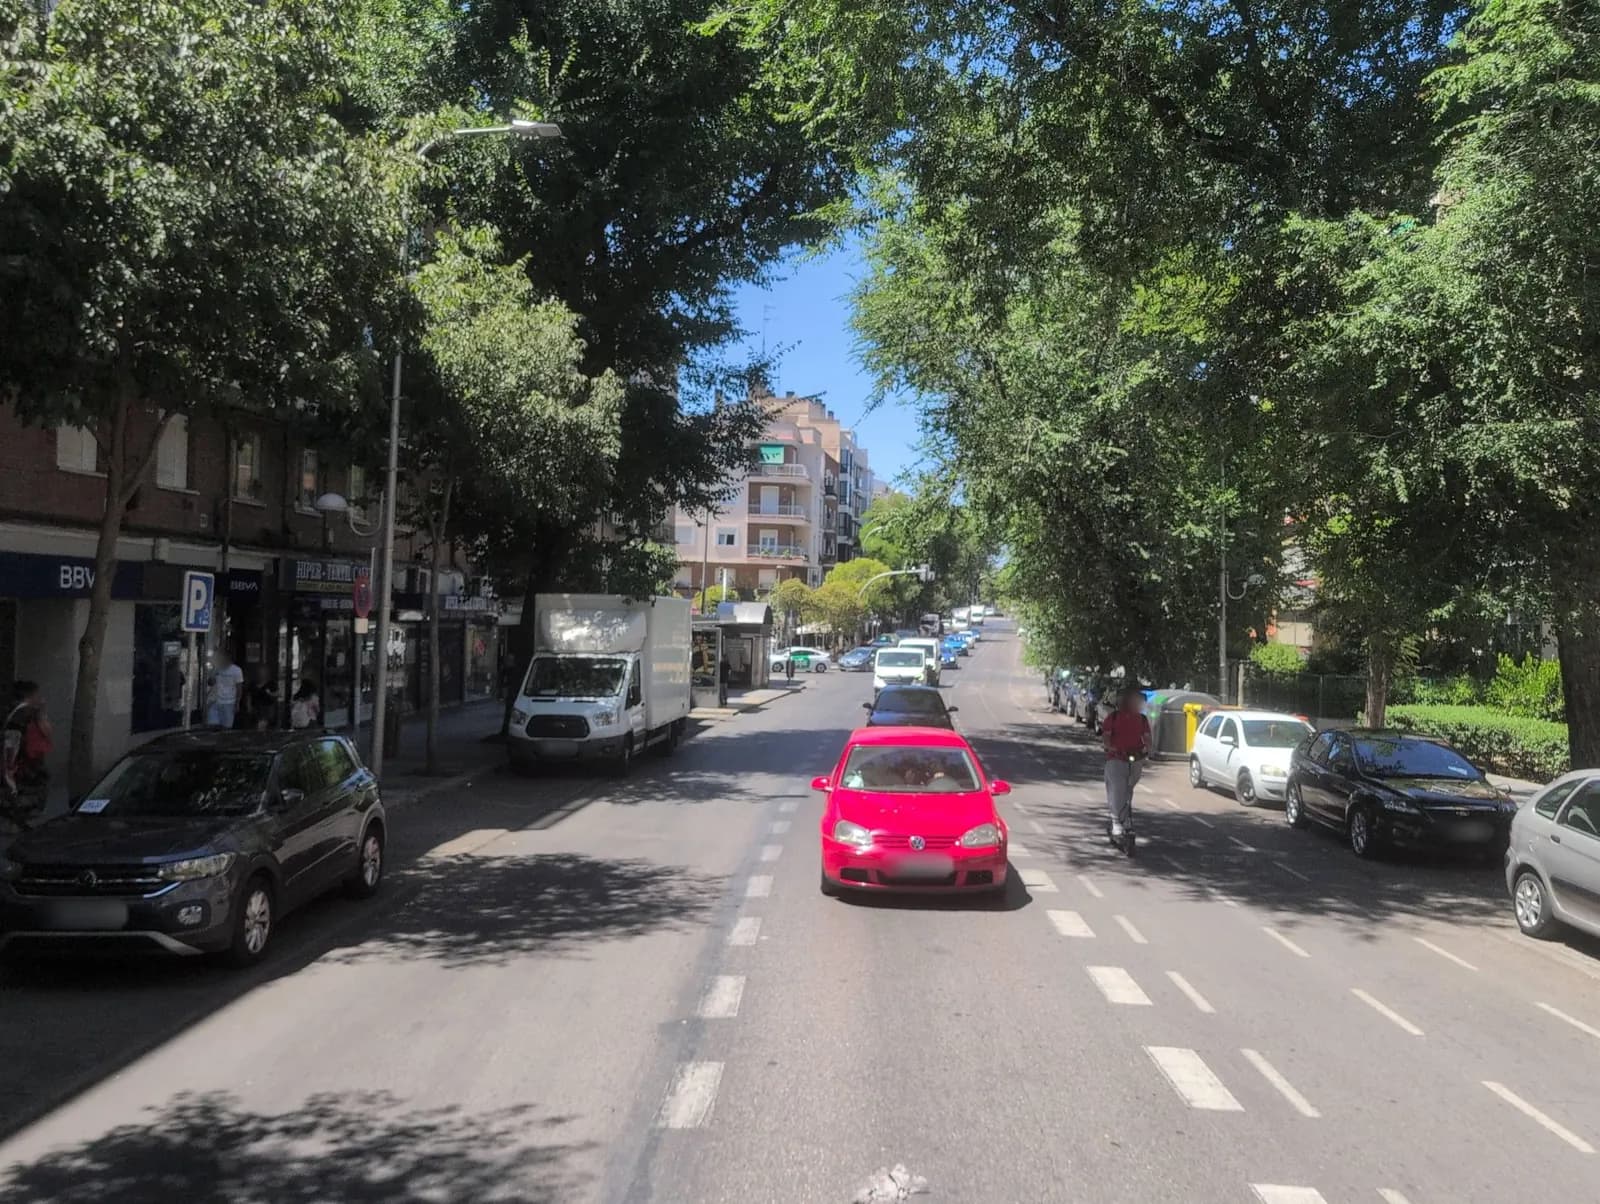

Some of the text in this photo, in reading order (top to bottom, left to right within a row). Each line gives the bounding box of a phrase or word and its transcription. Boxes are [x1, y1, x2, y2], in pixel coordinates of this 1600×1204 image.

[60, 565, 96, 589] BBV
[230, 580, 259, 591] BBVA
[189, 579, 208, 624] P
